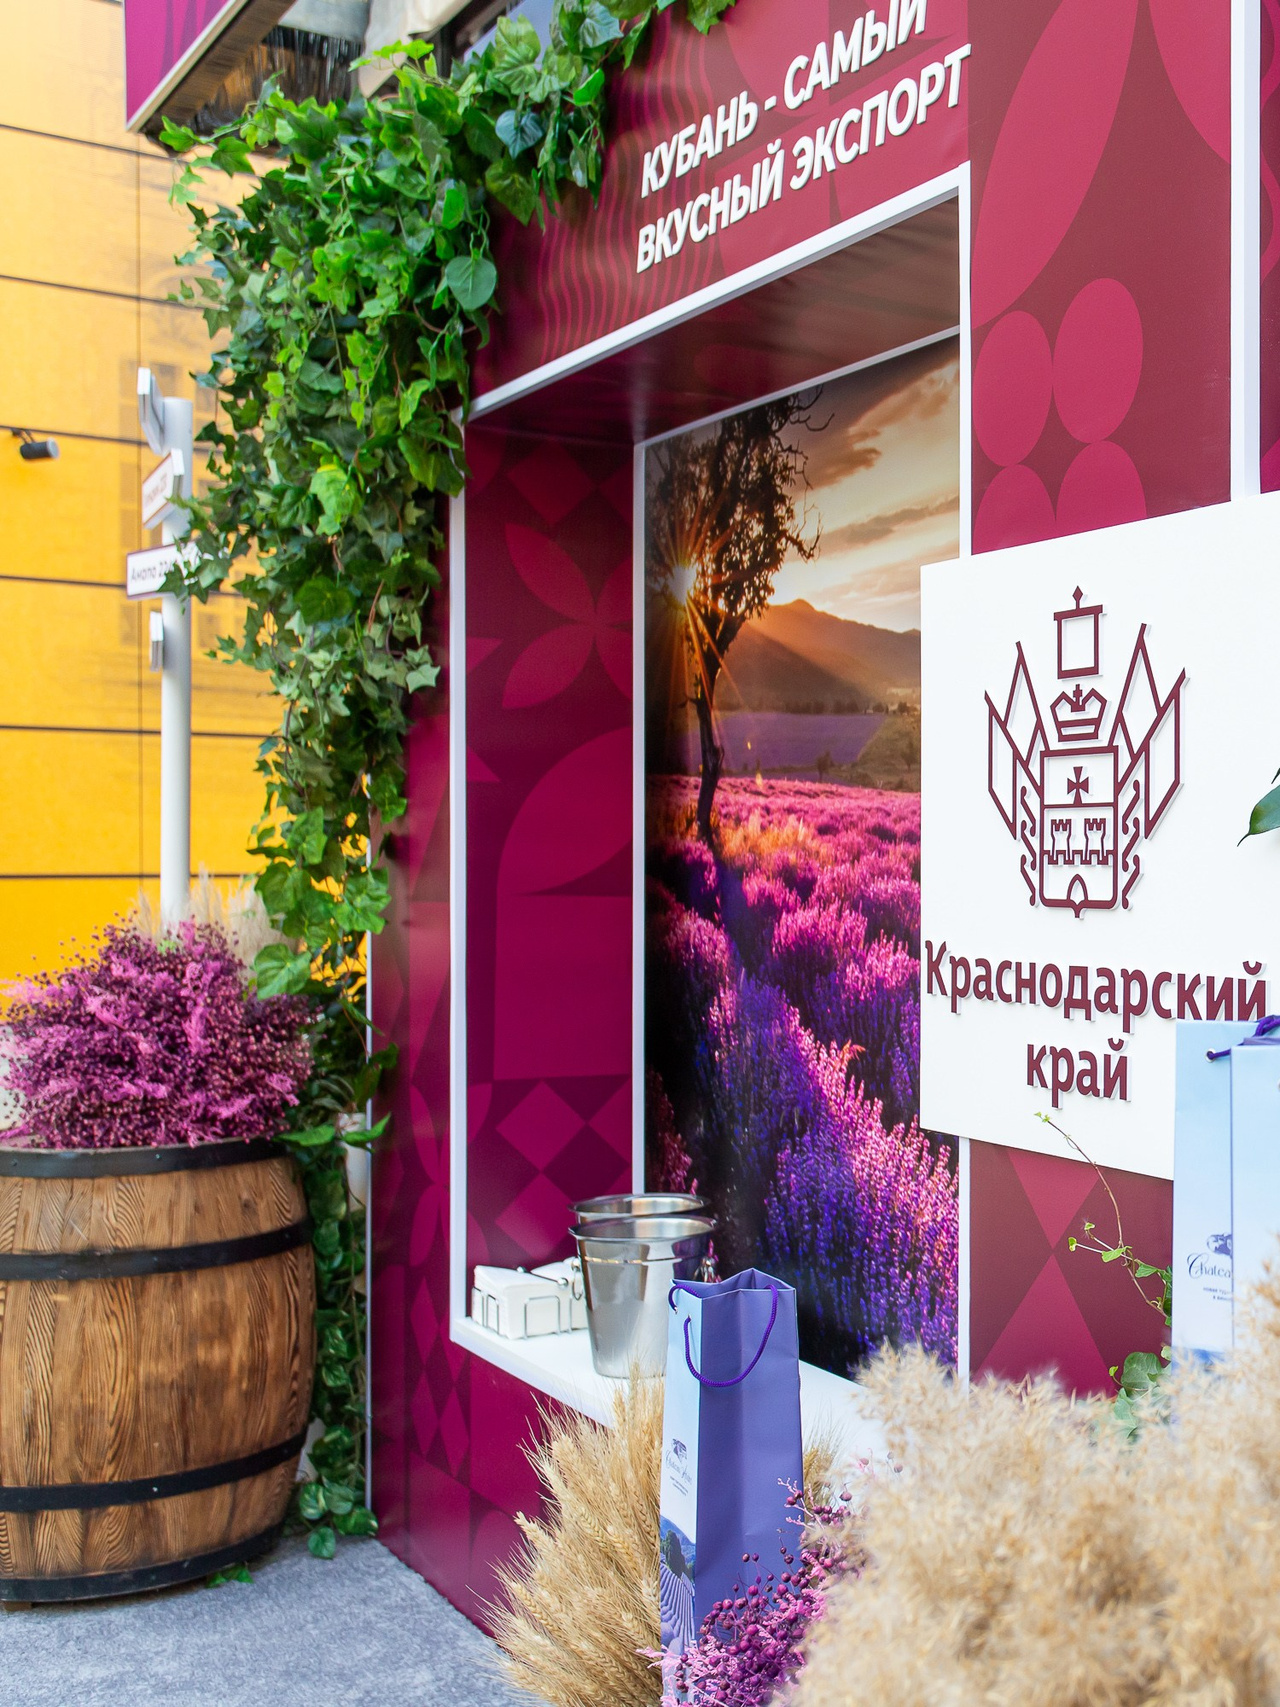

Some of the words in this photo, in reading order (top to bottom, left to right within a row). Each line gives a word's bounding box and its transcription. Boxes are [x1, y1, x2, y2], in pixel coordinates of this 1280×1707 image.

[636, 139, 787, 274] ВКУСНЫЙ
[789, 43, 972, 191] ЭКСПОРТ
[641, 90, 759, 199] КУБАНЬ
[764, 95, 778, 112] -
[925, 940, 1270, 1034] Краснодарский
[1026, 1037, 1132, 1109] край
[1187, 1253, 1231, 1279] Chatea
